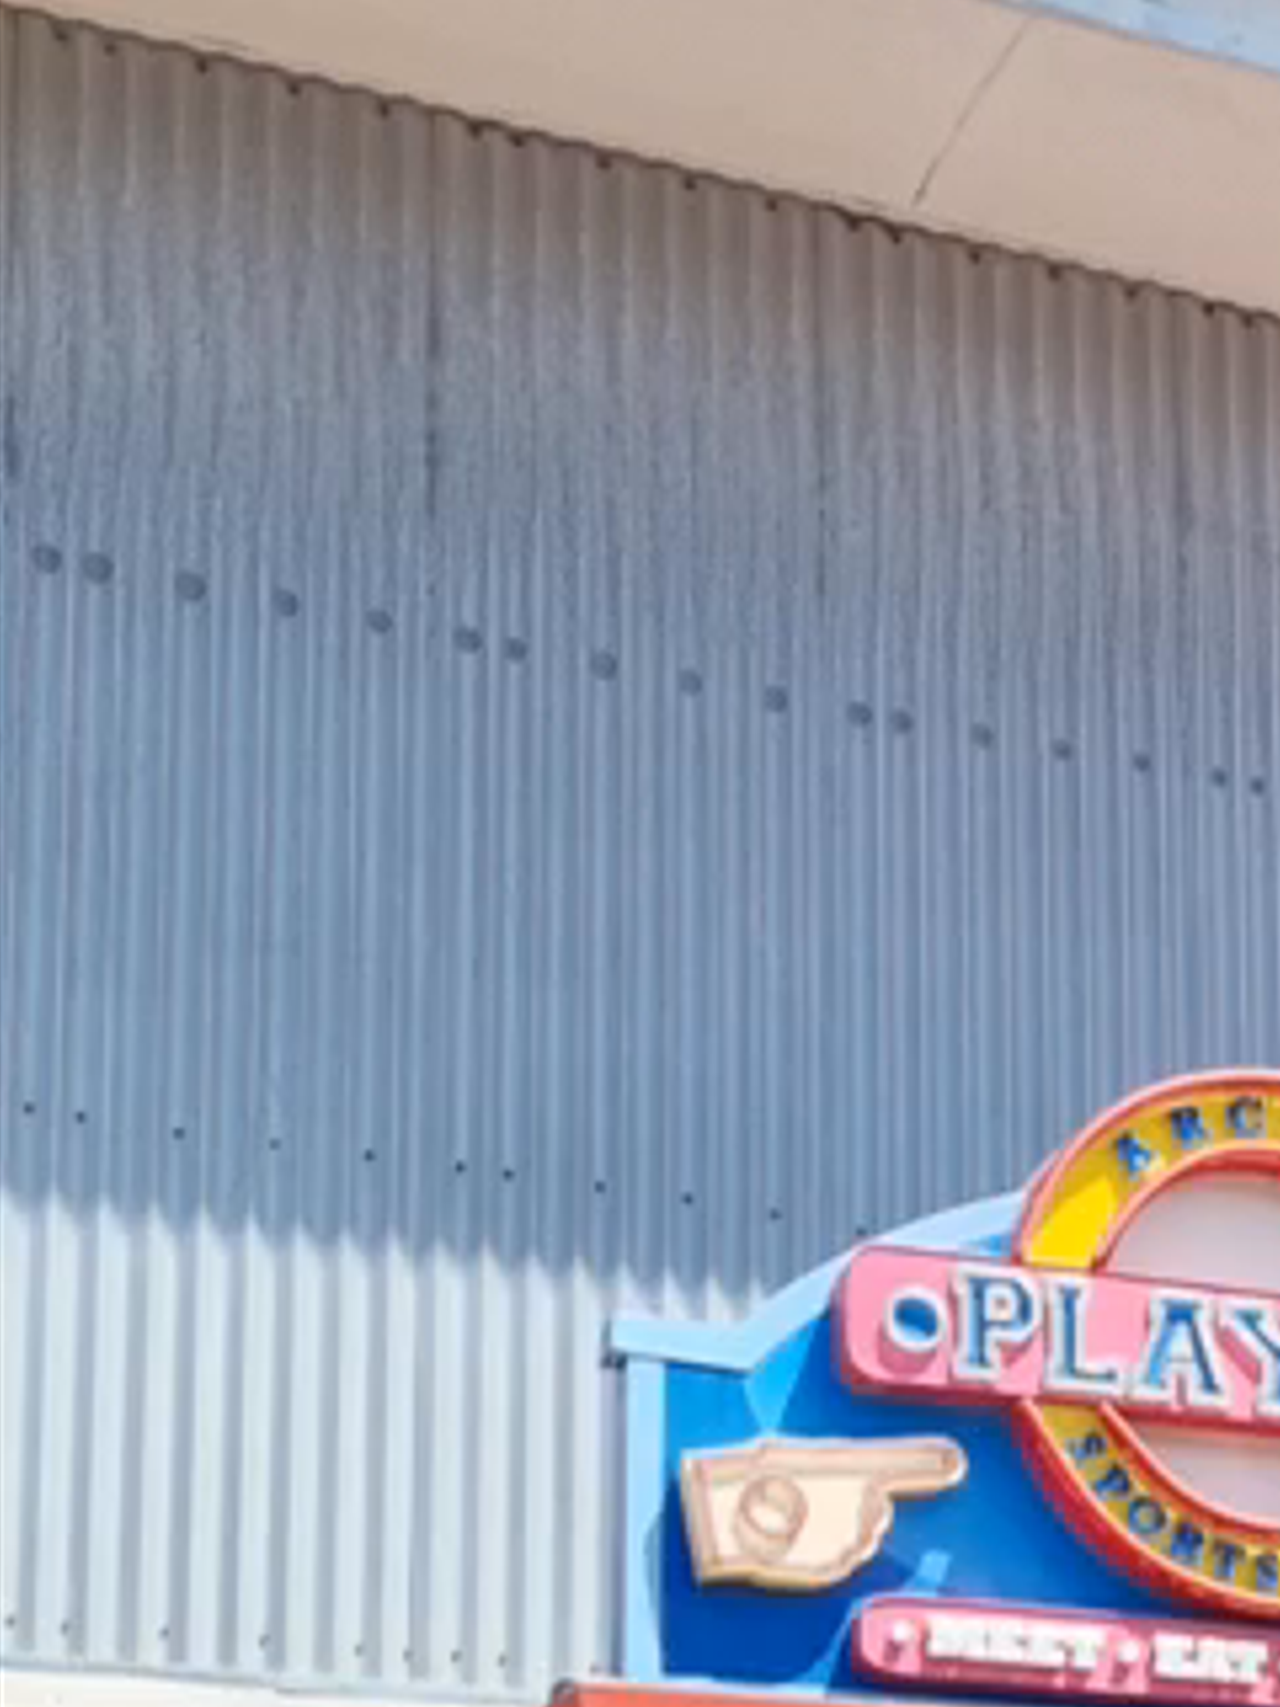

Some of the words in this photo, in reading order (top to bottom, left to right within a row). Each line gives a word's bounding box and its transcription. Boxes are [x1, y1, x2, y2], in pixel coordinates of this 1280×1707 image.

[1070, 1430, 1280, 1591] SPORTS
[925, 1614, 1108, 1671] MEET
[1152, 1631, 1271, 1686] EAT
